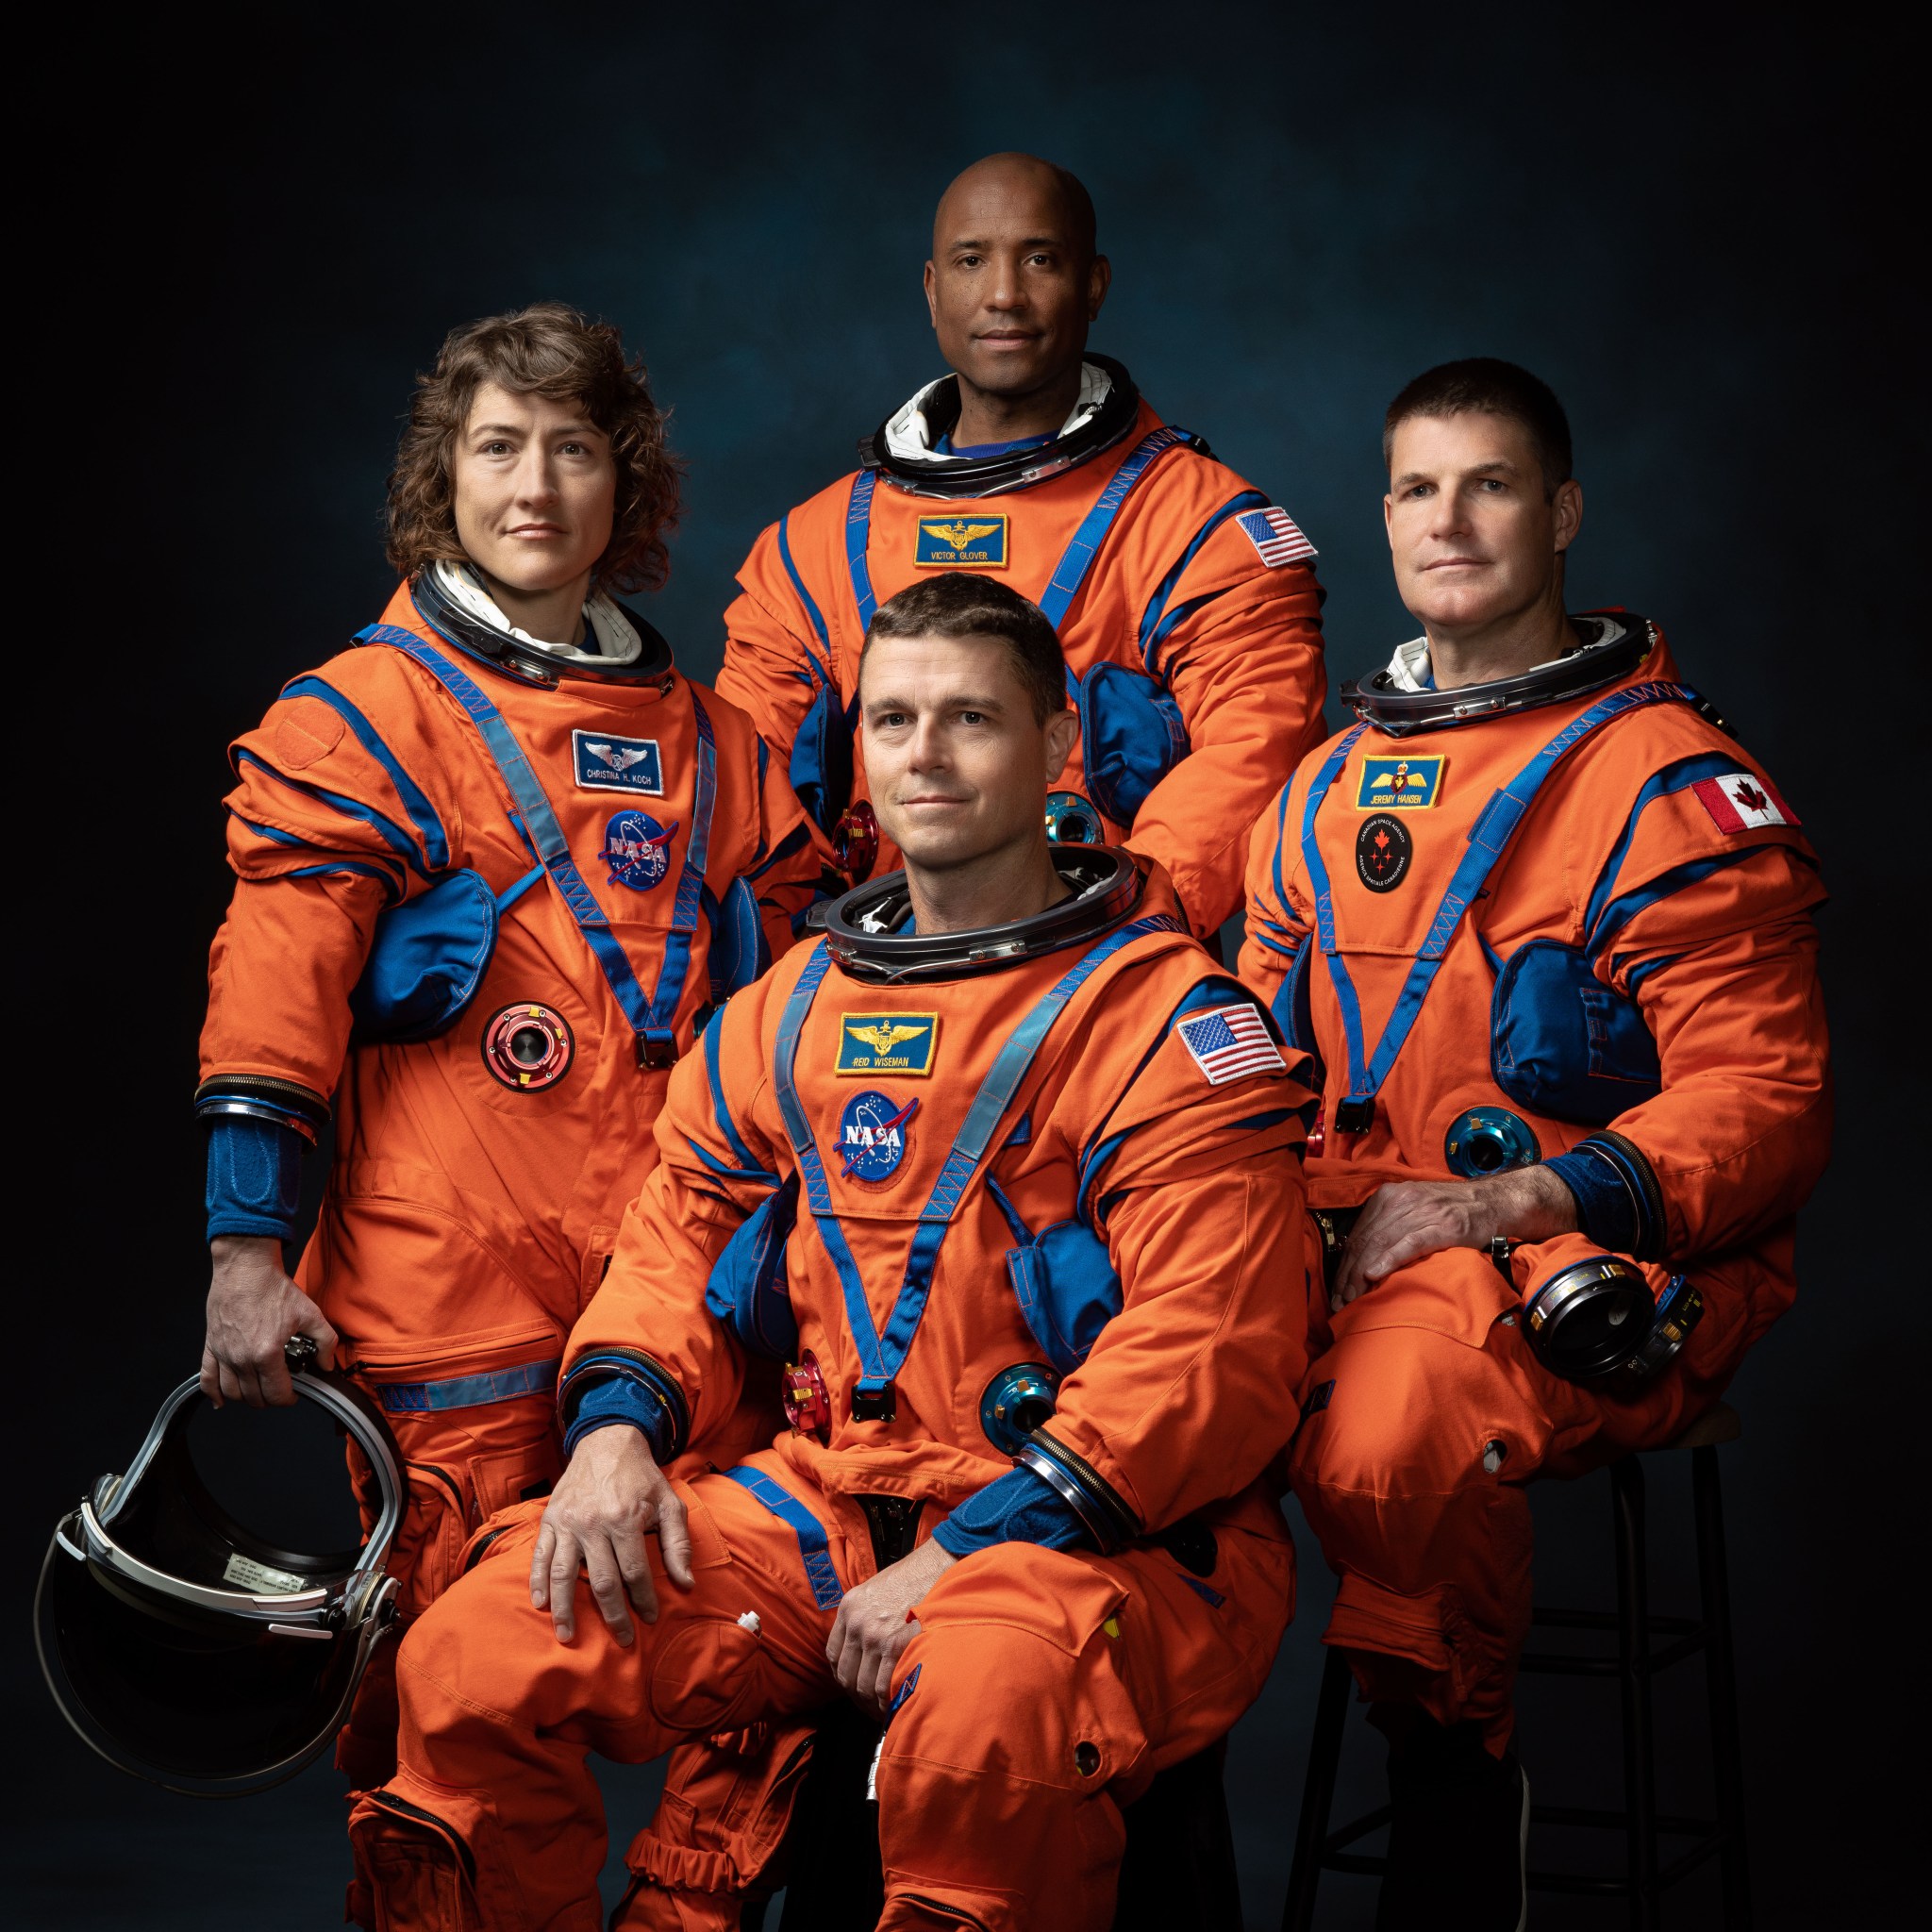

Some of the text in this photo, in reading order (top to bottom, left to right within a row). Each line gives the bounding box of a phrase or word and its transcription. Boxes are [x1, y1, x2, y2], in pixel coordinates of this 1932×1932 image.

[931, 551, 988, 560] VICTOR GLOVER
[587, 769, 652, 785] CHRISTINA H. KOCH
[1370, 794, 1422, 805] JEREMY HANSEN
[1360, 818, 1406, 843] CANADIAN SPACE AGENCY
[609, 837, 667, 864] NASA
[1359, 855, 1406, 886] AGENCE SPATIALE CANADIENNE
[853, 1057, 909, 1067] REID WISEMAN
[845, 1125, 901, 1148] NASA
